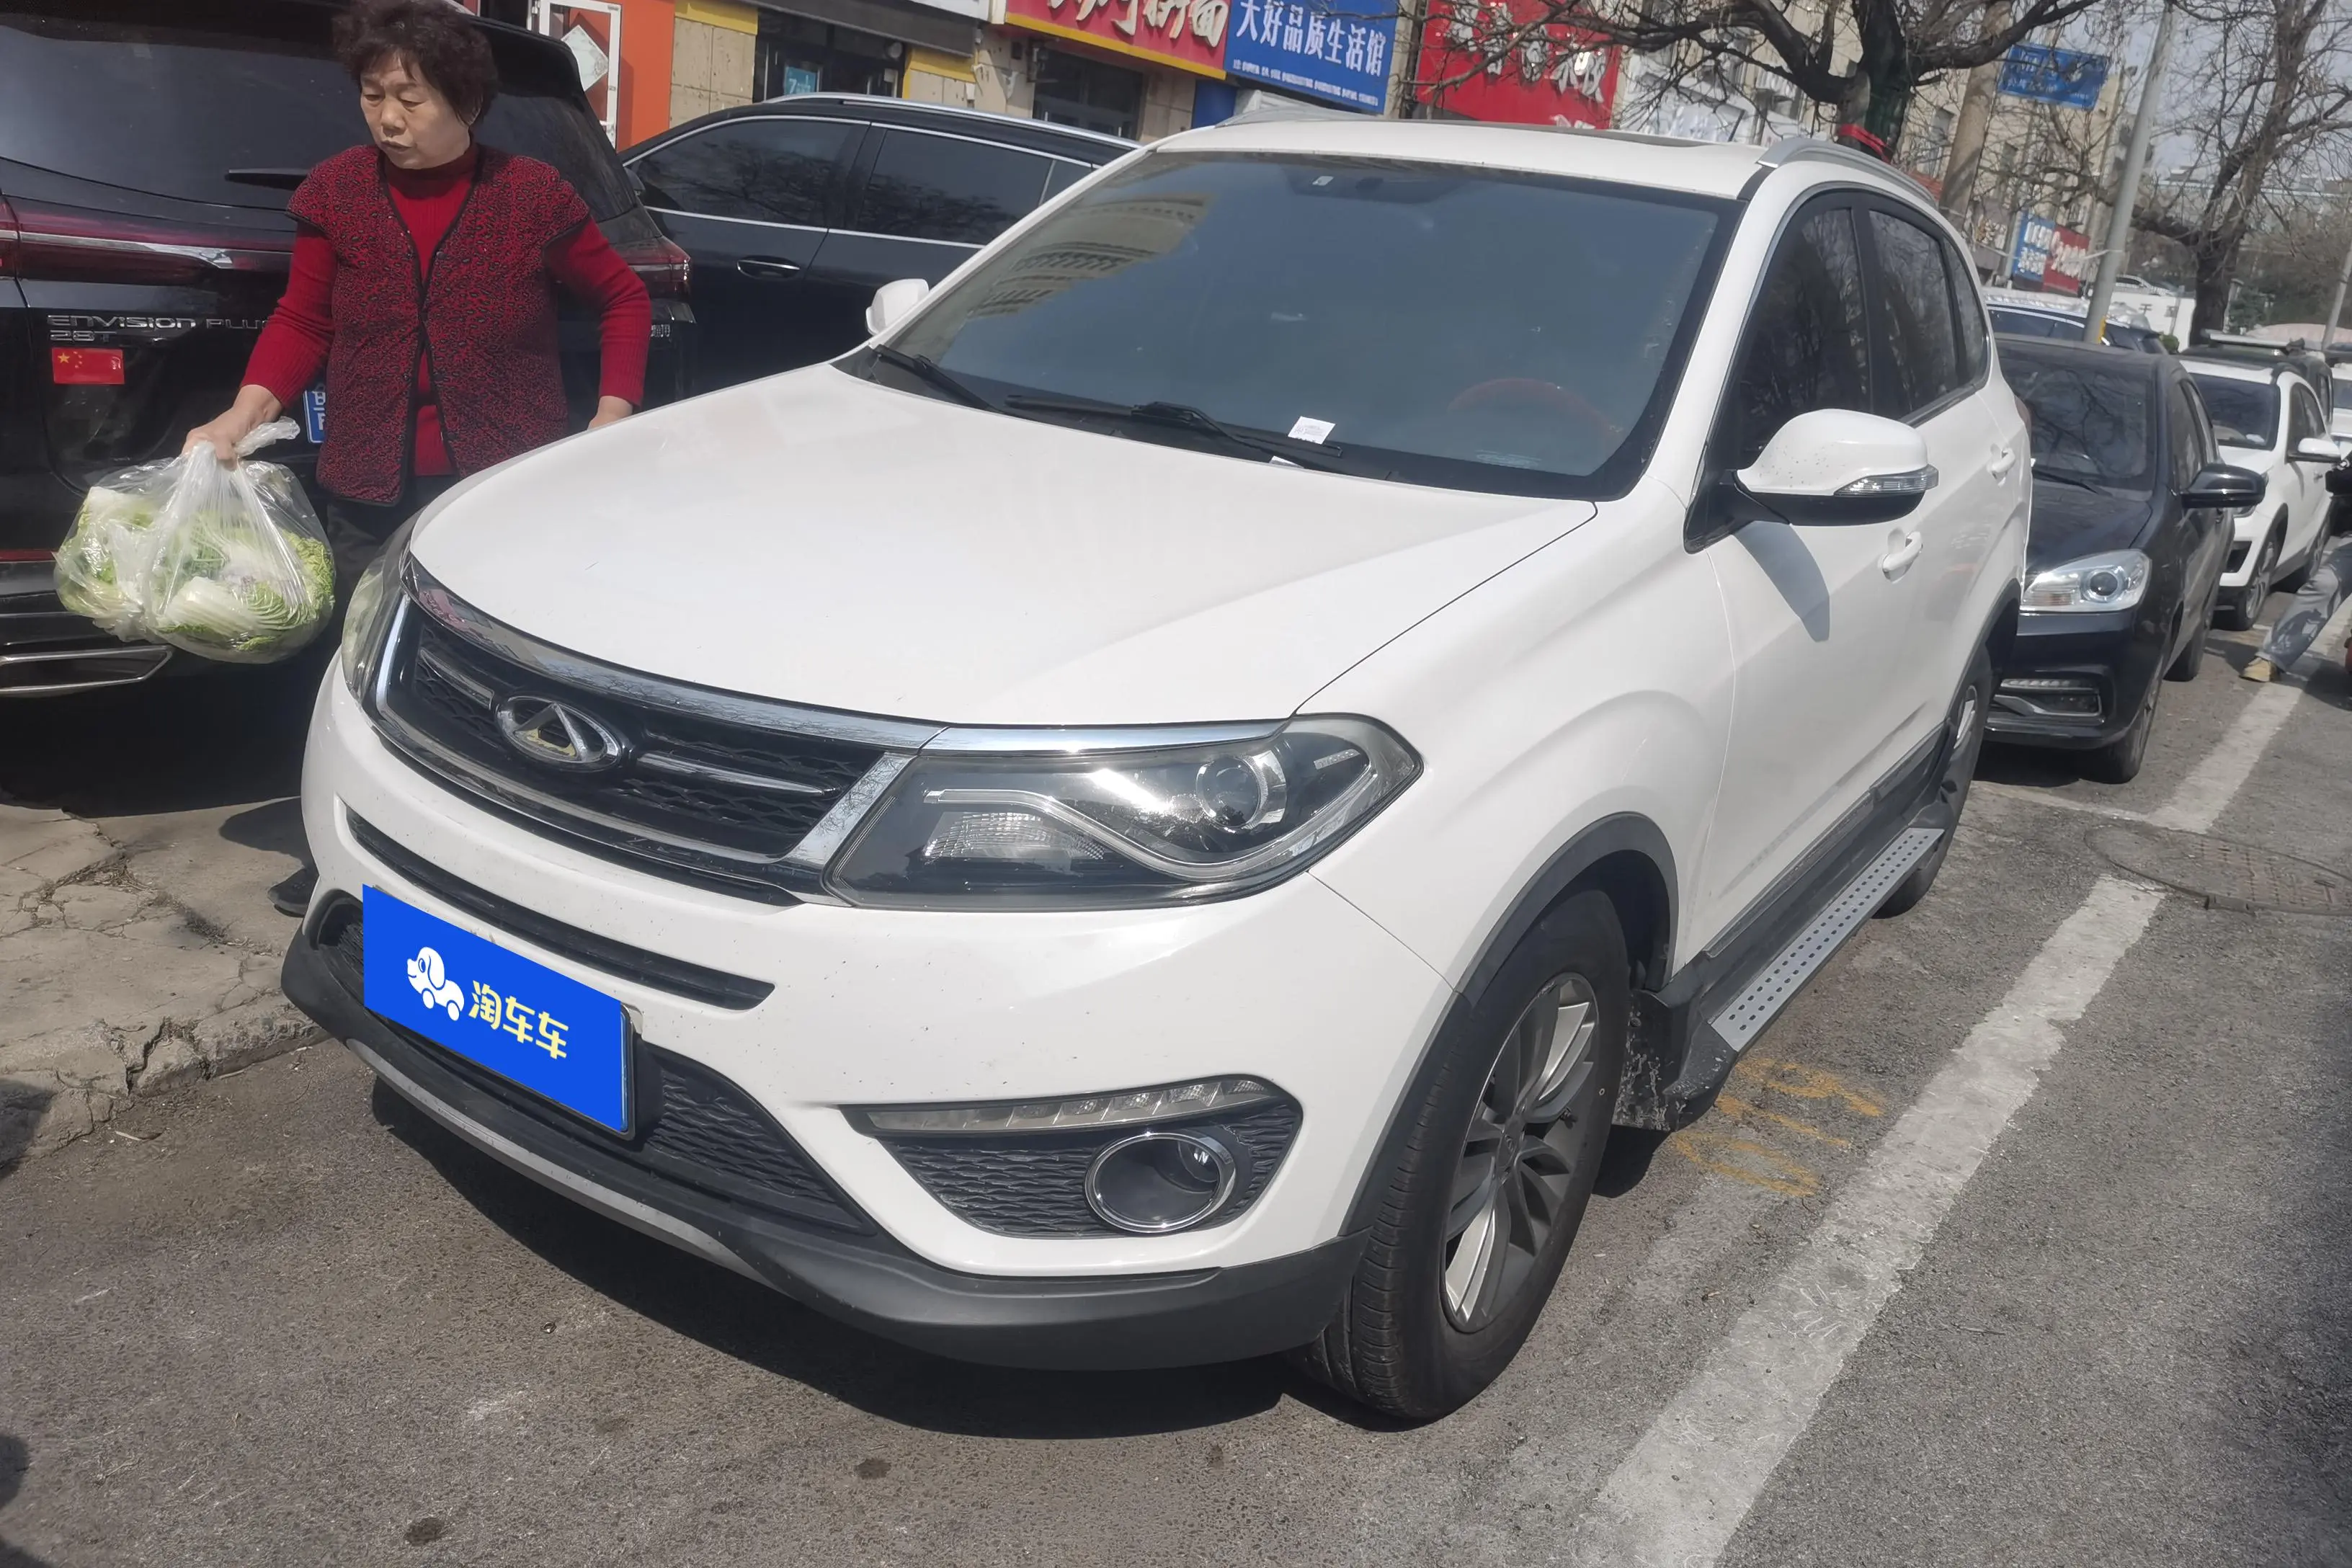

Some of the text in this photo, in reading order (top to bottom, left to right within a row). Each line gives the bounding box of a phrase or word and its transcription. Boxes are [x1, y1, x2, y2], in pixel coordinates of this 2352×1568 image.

[1236, 0, 1386, 76] 大好品质生活馆
[47, 314, 196, 329] ENVISION
[50, 329, 117, 342] 28T
